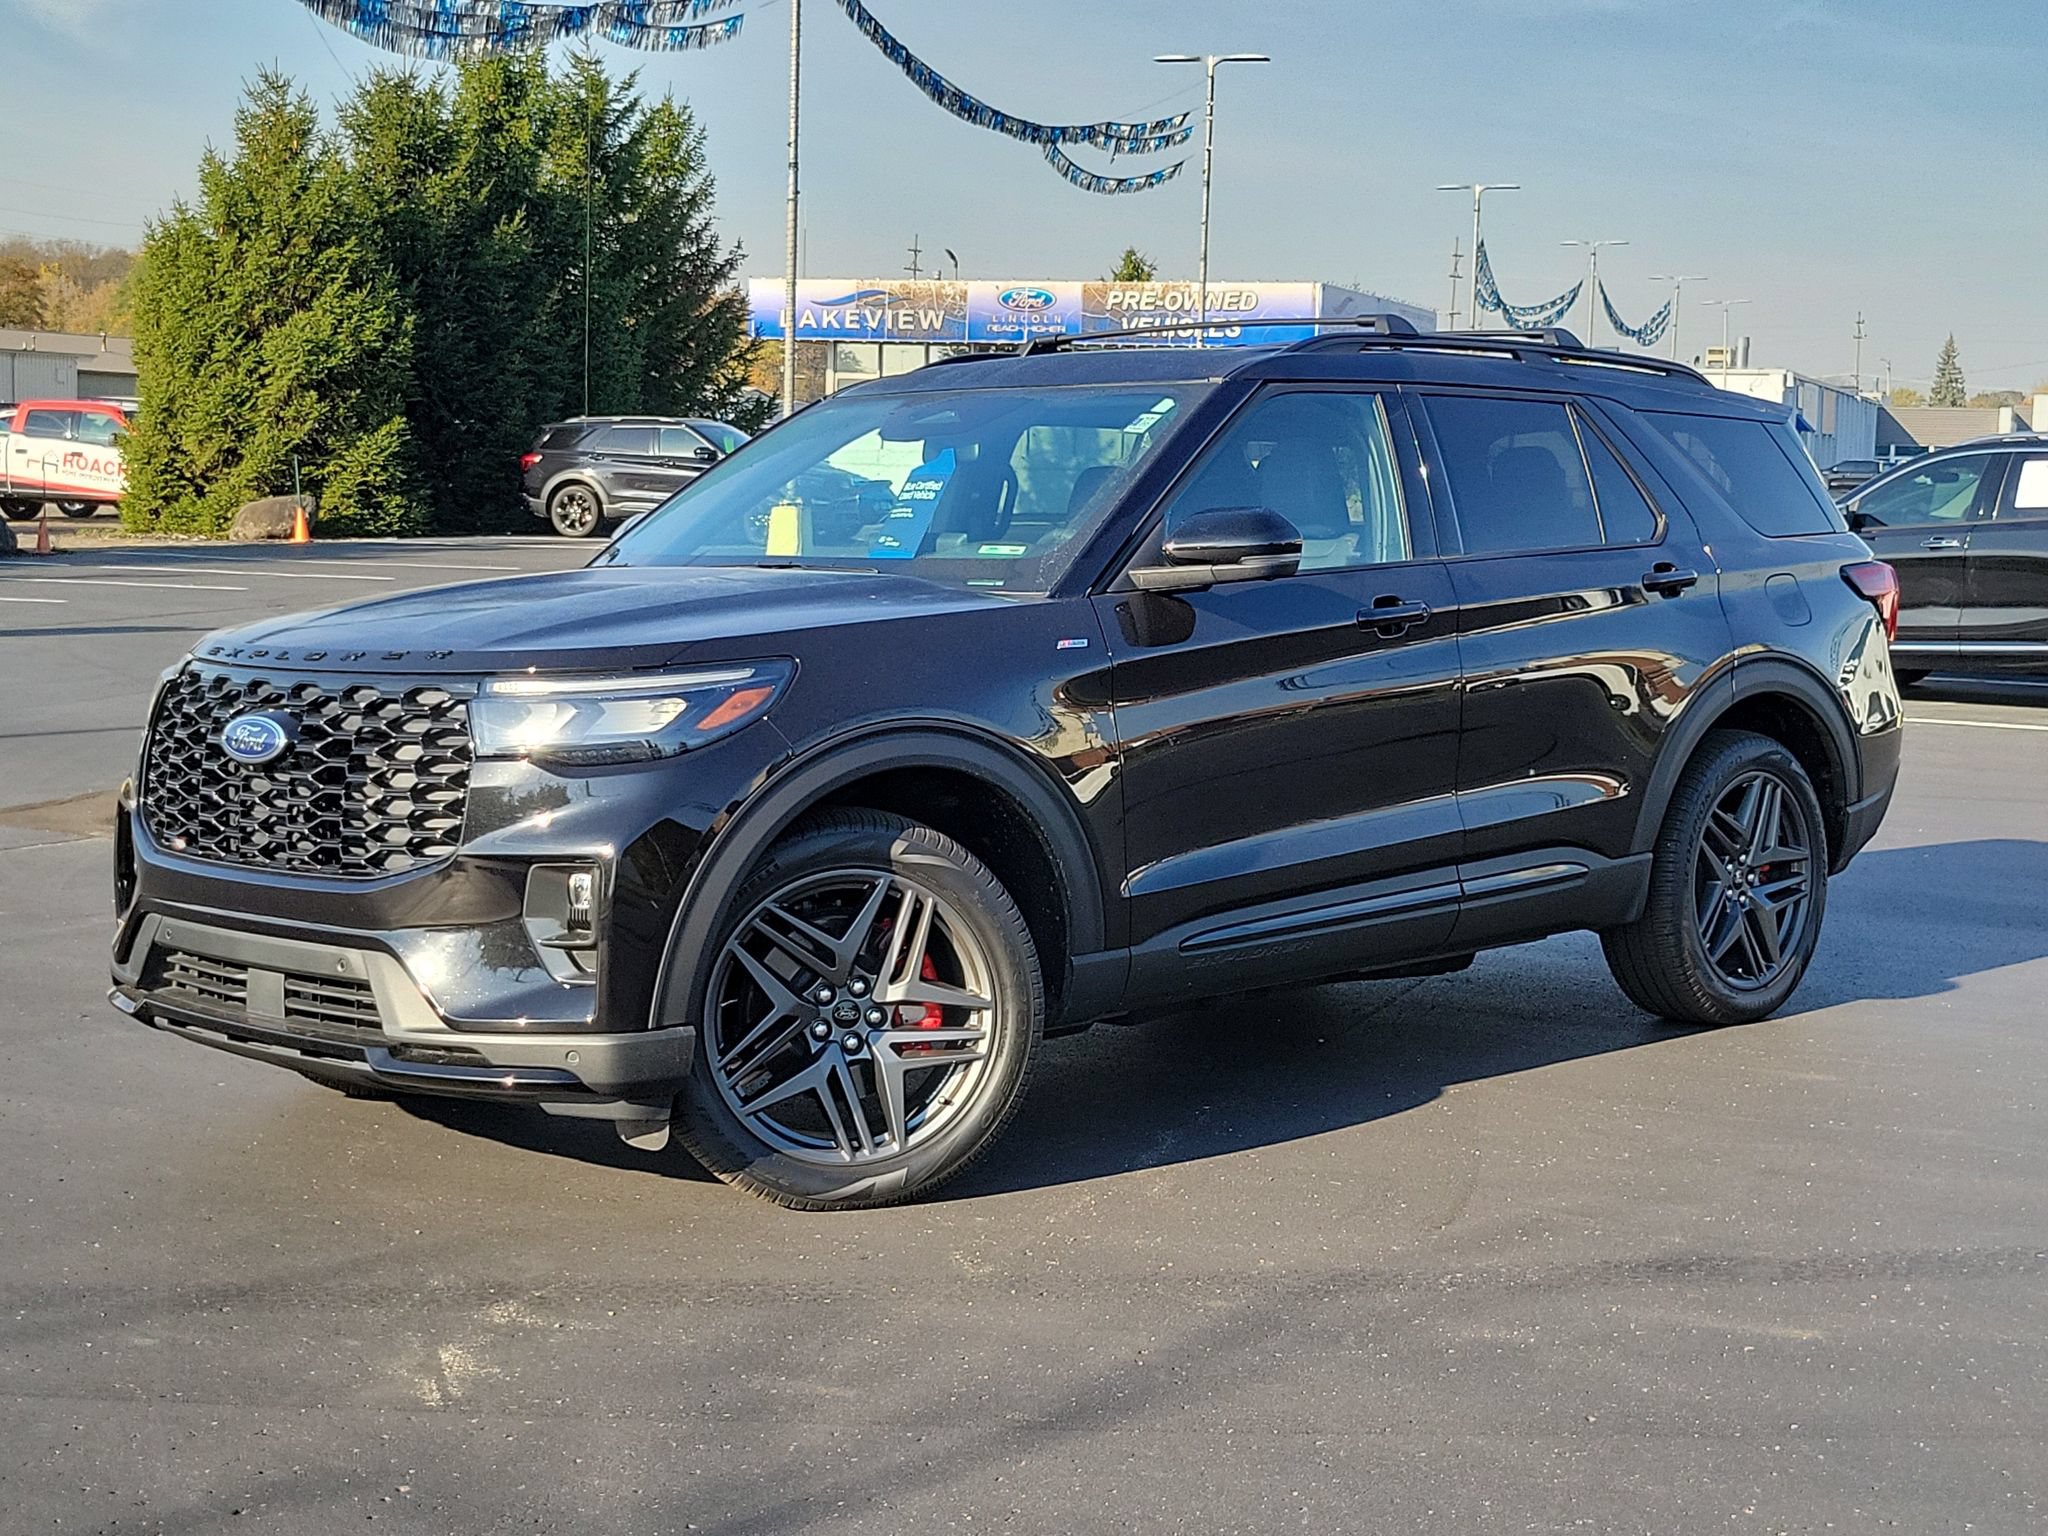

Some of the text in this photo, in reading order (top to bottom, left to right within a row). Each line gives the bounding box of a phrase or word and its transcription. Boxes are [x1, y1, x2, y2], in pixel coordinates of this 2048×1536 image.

[1008, 290, 1046, 308] Ford
[1106, 290, 1259, 312] PRE-OWNED
[778, 308, 945, 331] LAKEVIEW
[992, 314, 1063, 324] LINCOLN
[207, 646, 454, 662] EXPLORER
[231, 724, 266, 752] Ford
